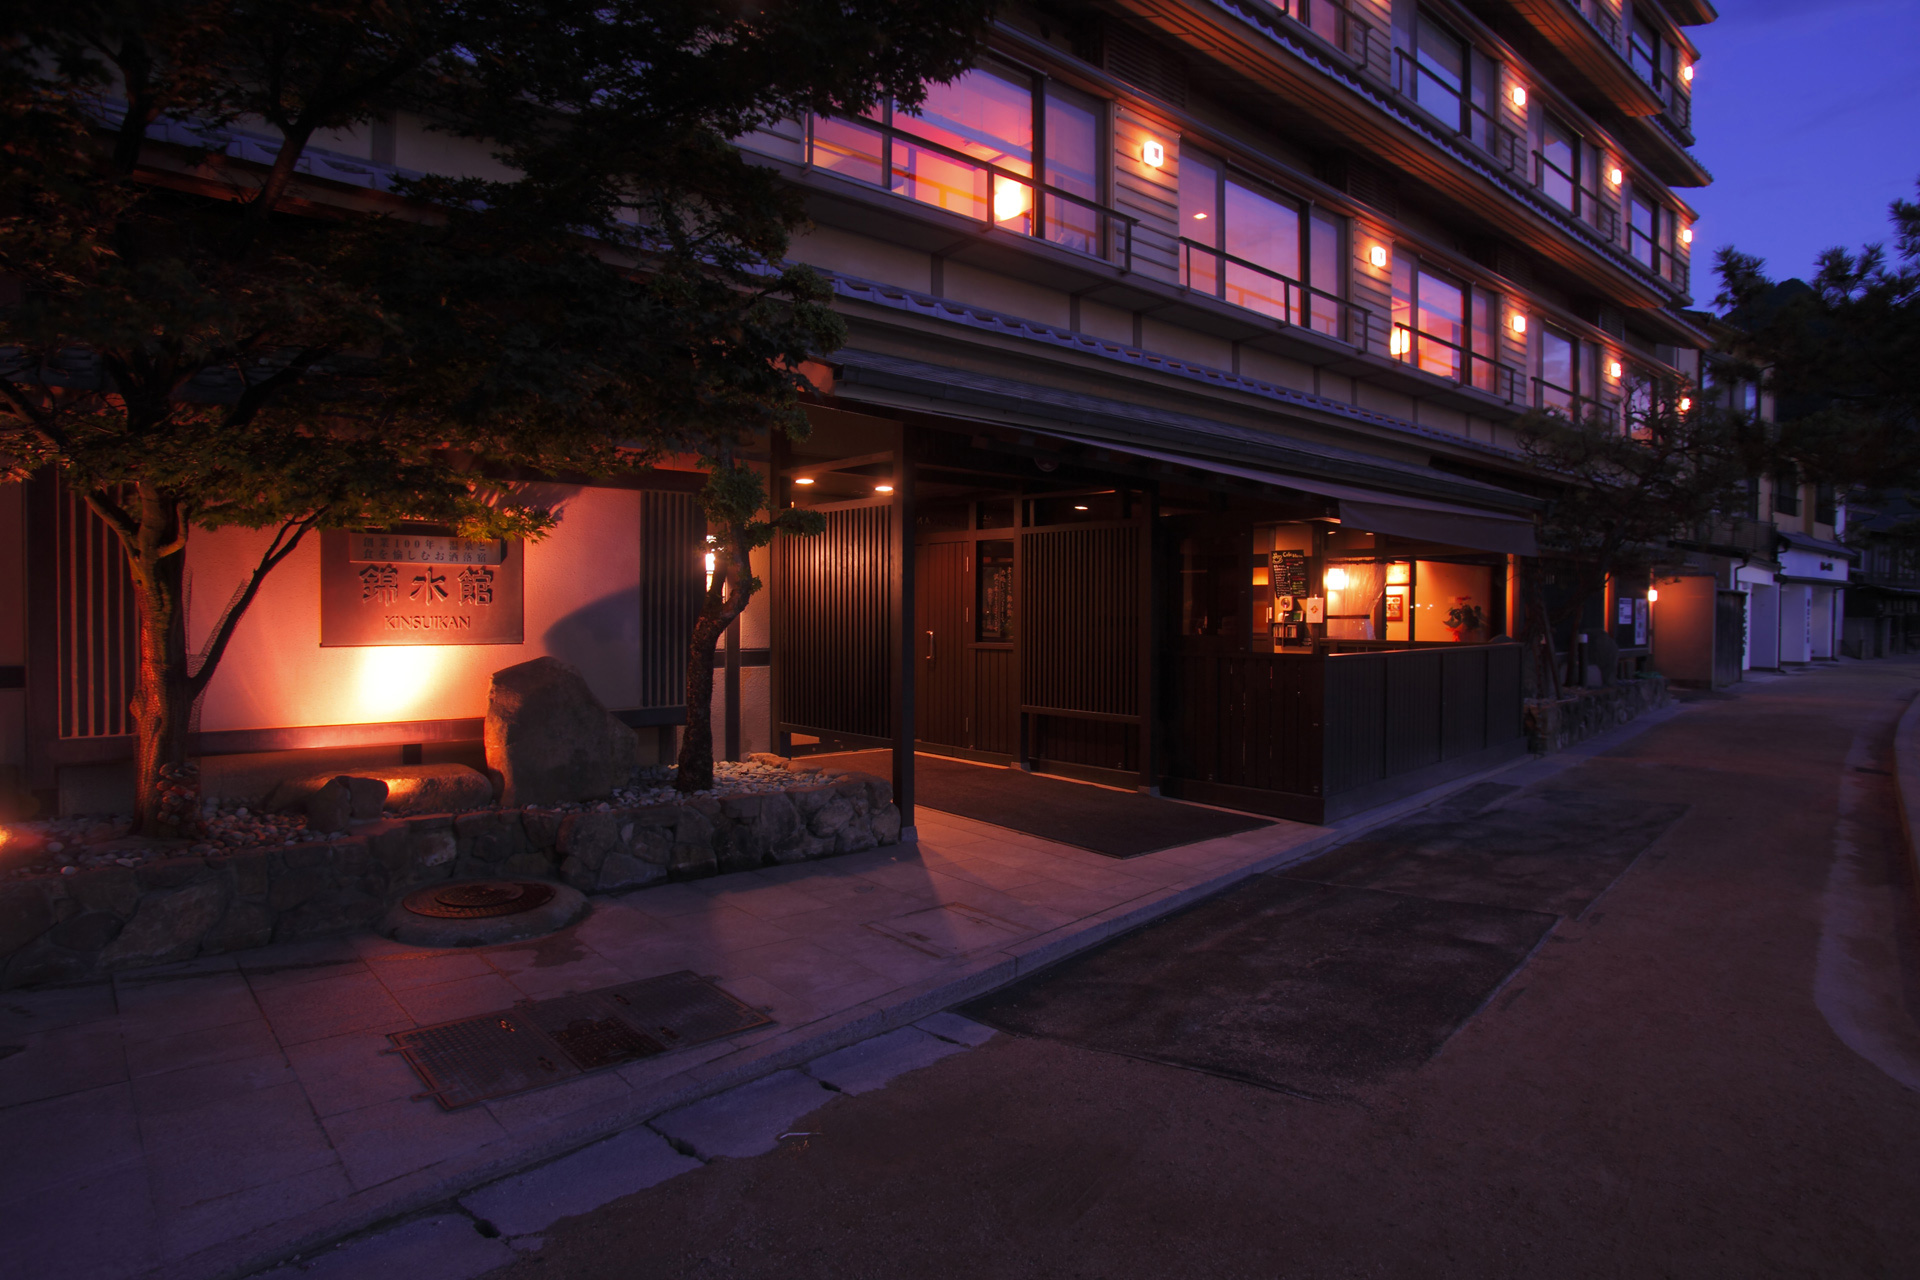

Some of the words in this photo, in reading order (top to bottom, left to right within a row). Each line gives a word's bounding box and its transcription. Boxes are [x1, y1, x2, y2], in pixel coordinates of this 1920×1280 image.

[363, 549, 487, 563] 食を愉しむお洒落宿
[359, 564, 494, 607] 錦水館
[384, 615, 471, 630] KINSUIKAN
